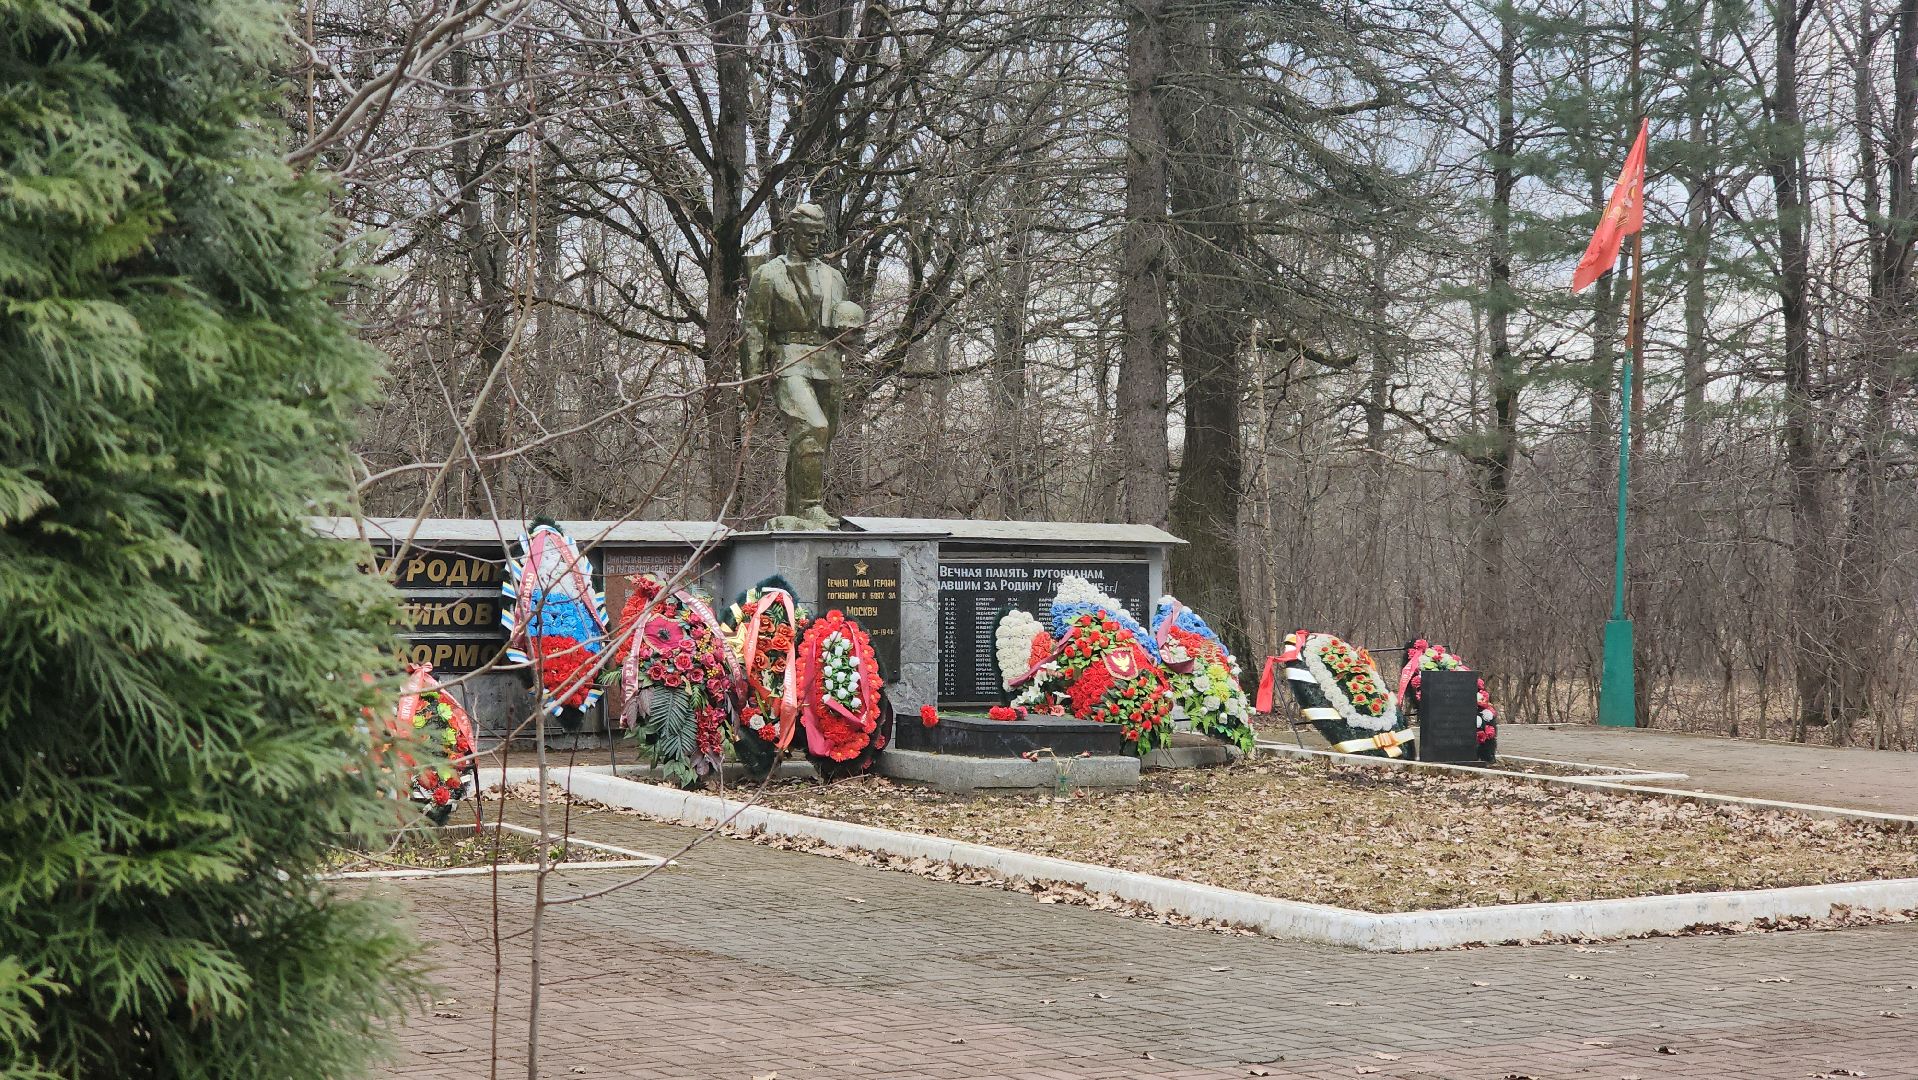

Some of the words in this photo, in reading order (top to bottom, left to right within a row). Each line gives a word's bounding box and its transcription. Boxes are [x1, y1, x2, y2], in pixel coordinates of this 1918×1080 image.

[985, 569, 1029, 578] ПАМЯТЬ
[874, 579, 896, 587] ГЕРОЯМ
[984, 581, 998, 591] ЗА
